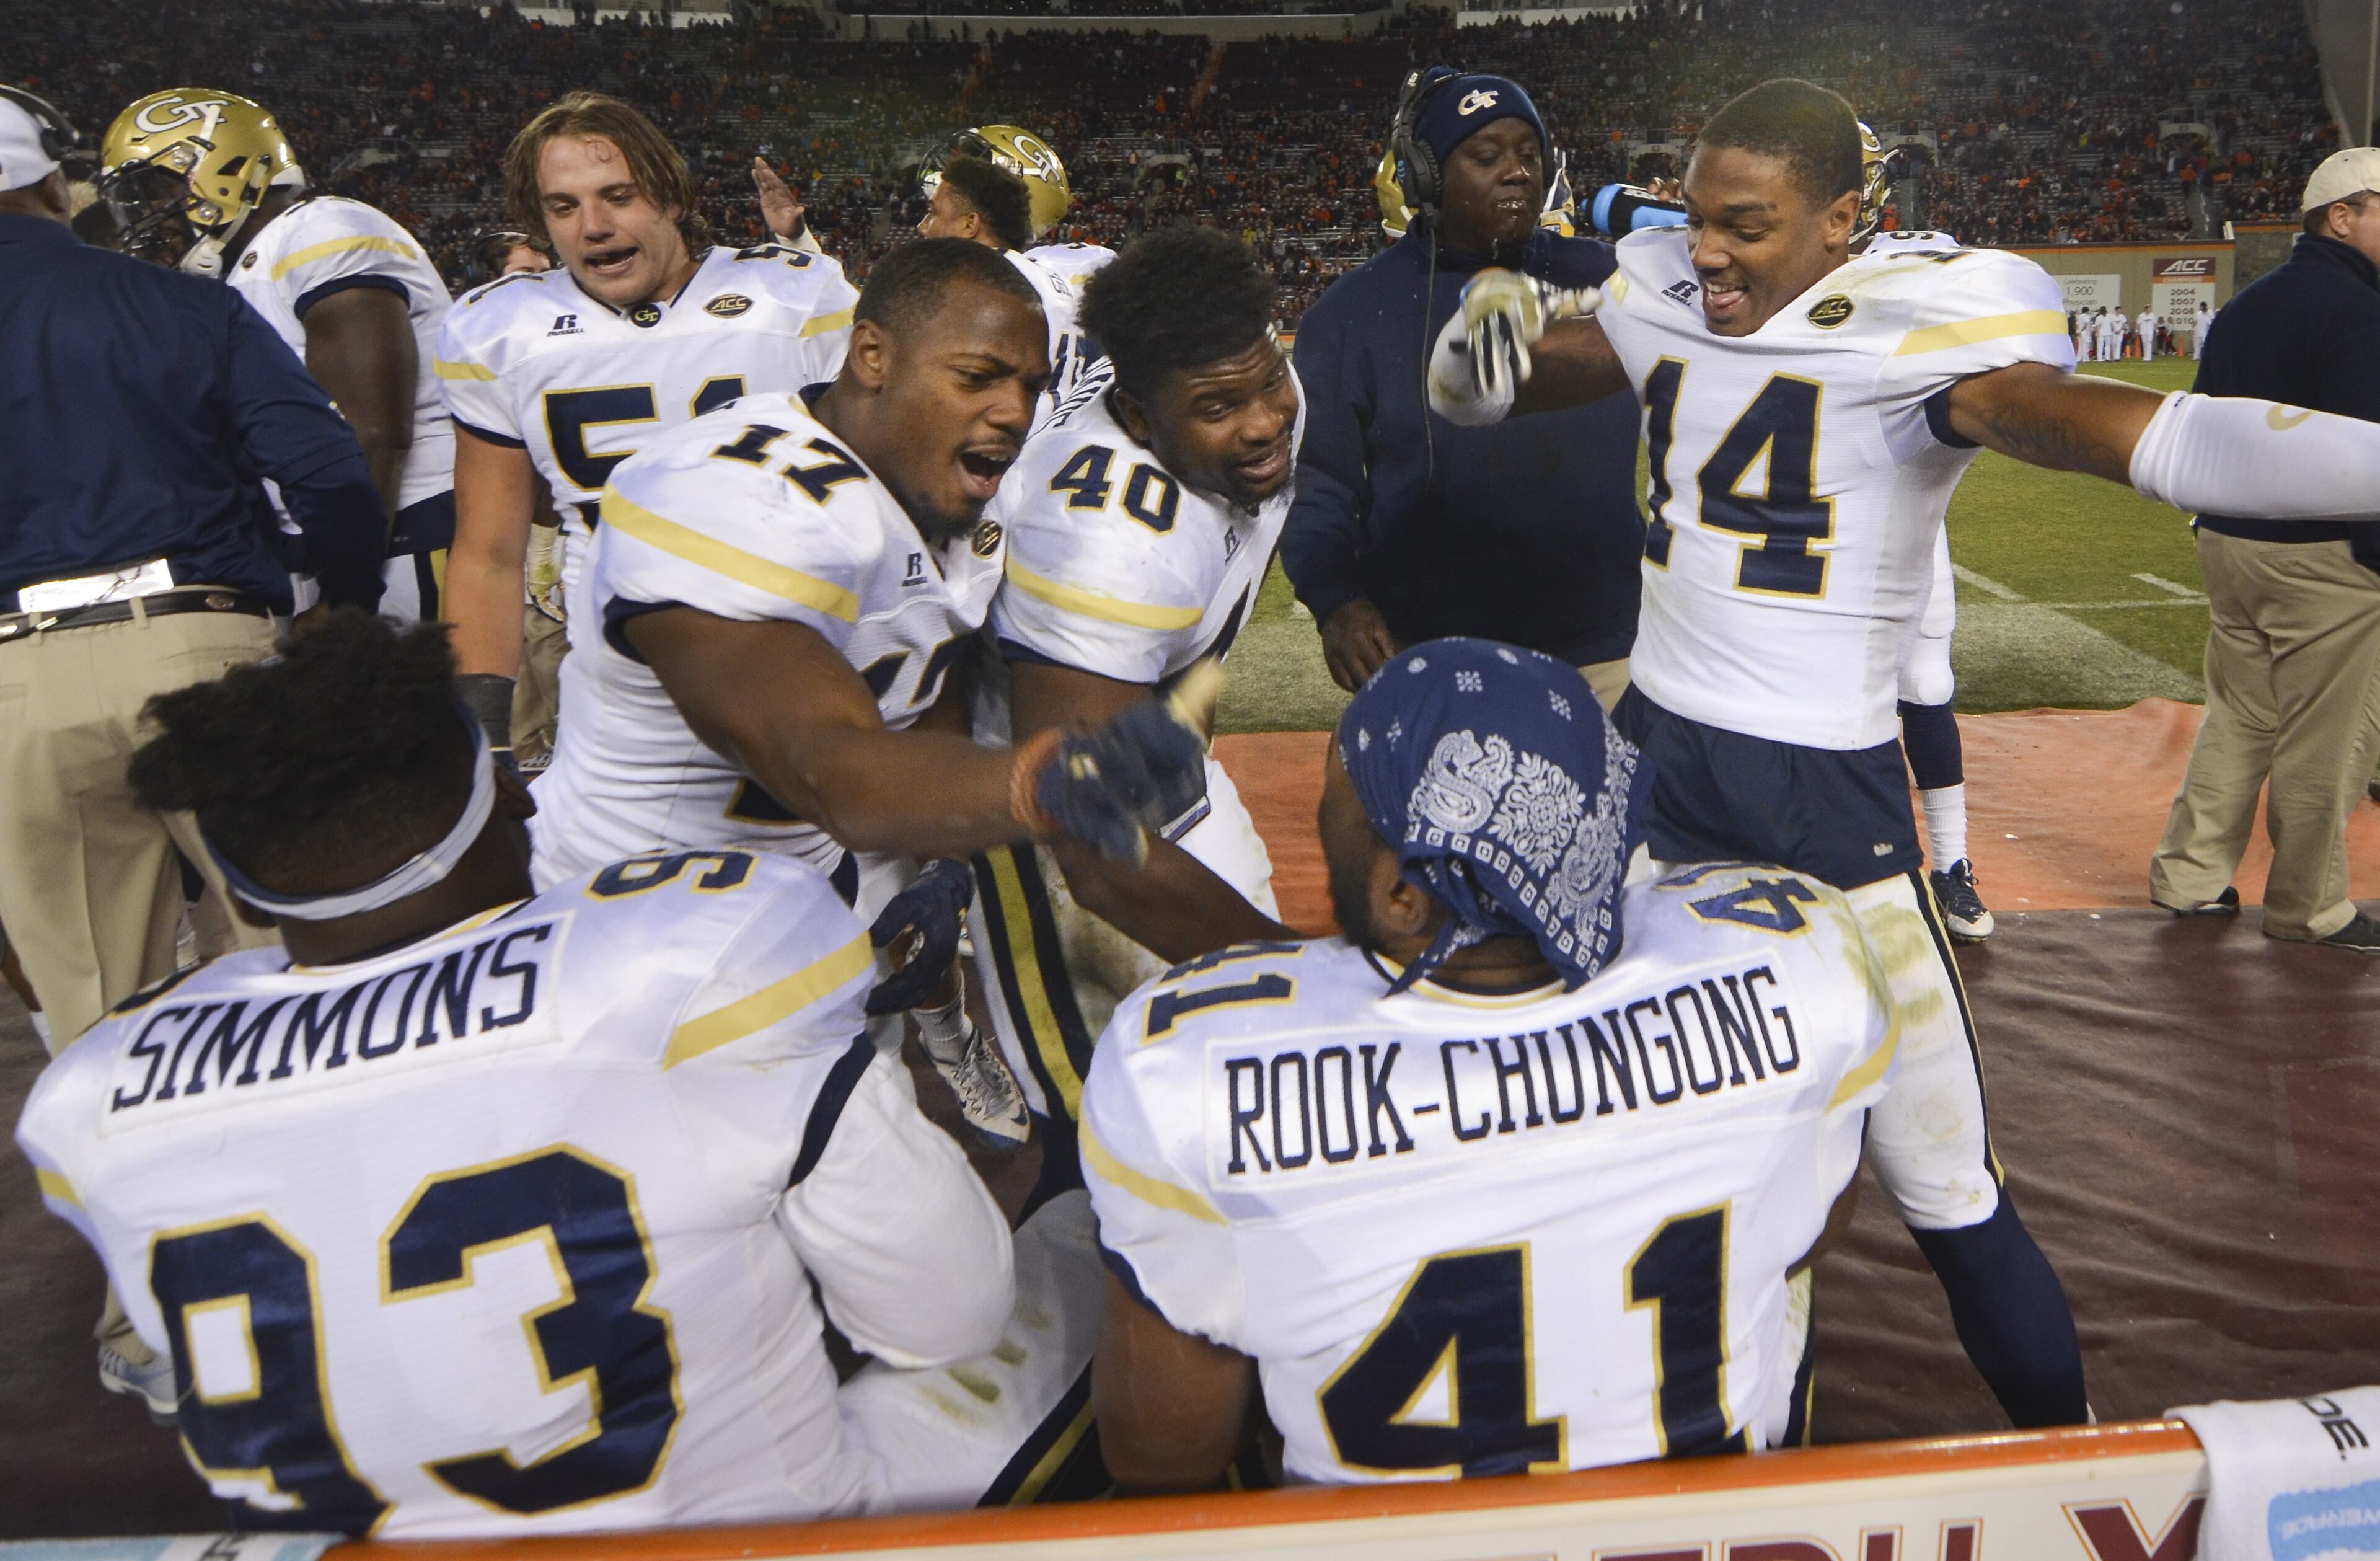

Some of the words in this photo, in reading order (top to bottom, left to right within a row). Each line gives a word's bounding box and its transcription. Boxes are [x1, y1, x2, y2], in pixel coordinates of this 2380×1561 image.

[711, 296, 748, 310] ACC
[1660, 288, 1692, 307] RUSSELL
[2164, 259, 2209, 272] ACC
[547, 327, 585, 337] RUSSELL
[710, 424, 869, 507] 17
[1048, 444, 1179, 537] 40
[1644, 353, 1836, 601] 14
[111, 924, 552, 1112] SIMMONS
[1225, 965, 1800, 1174] ROOK-CHUNGONG
[148, 1142, 686, 1540] 93
[1315, 1199, 1755, 1480] 41
